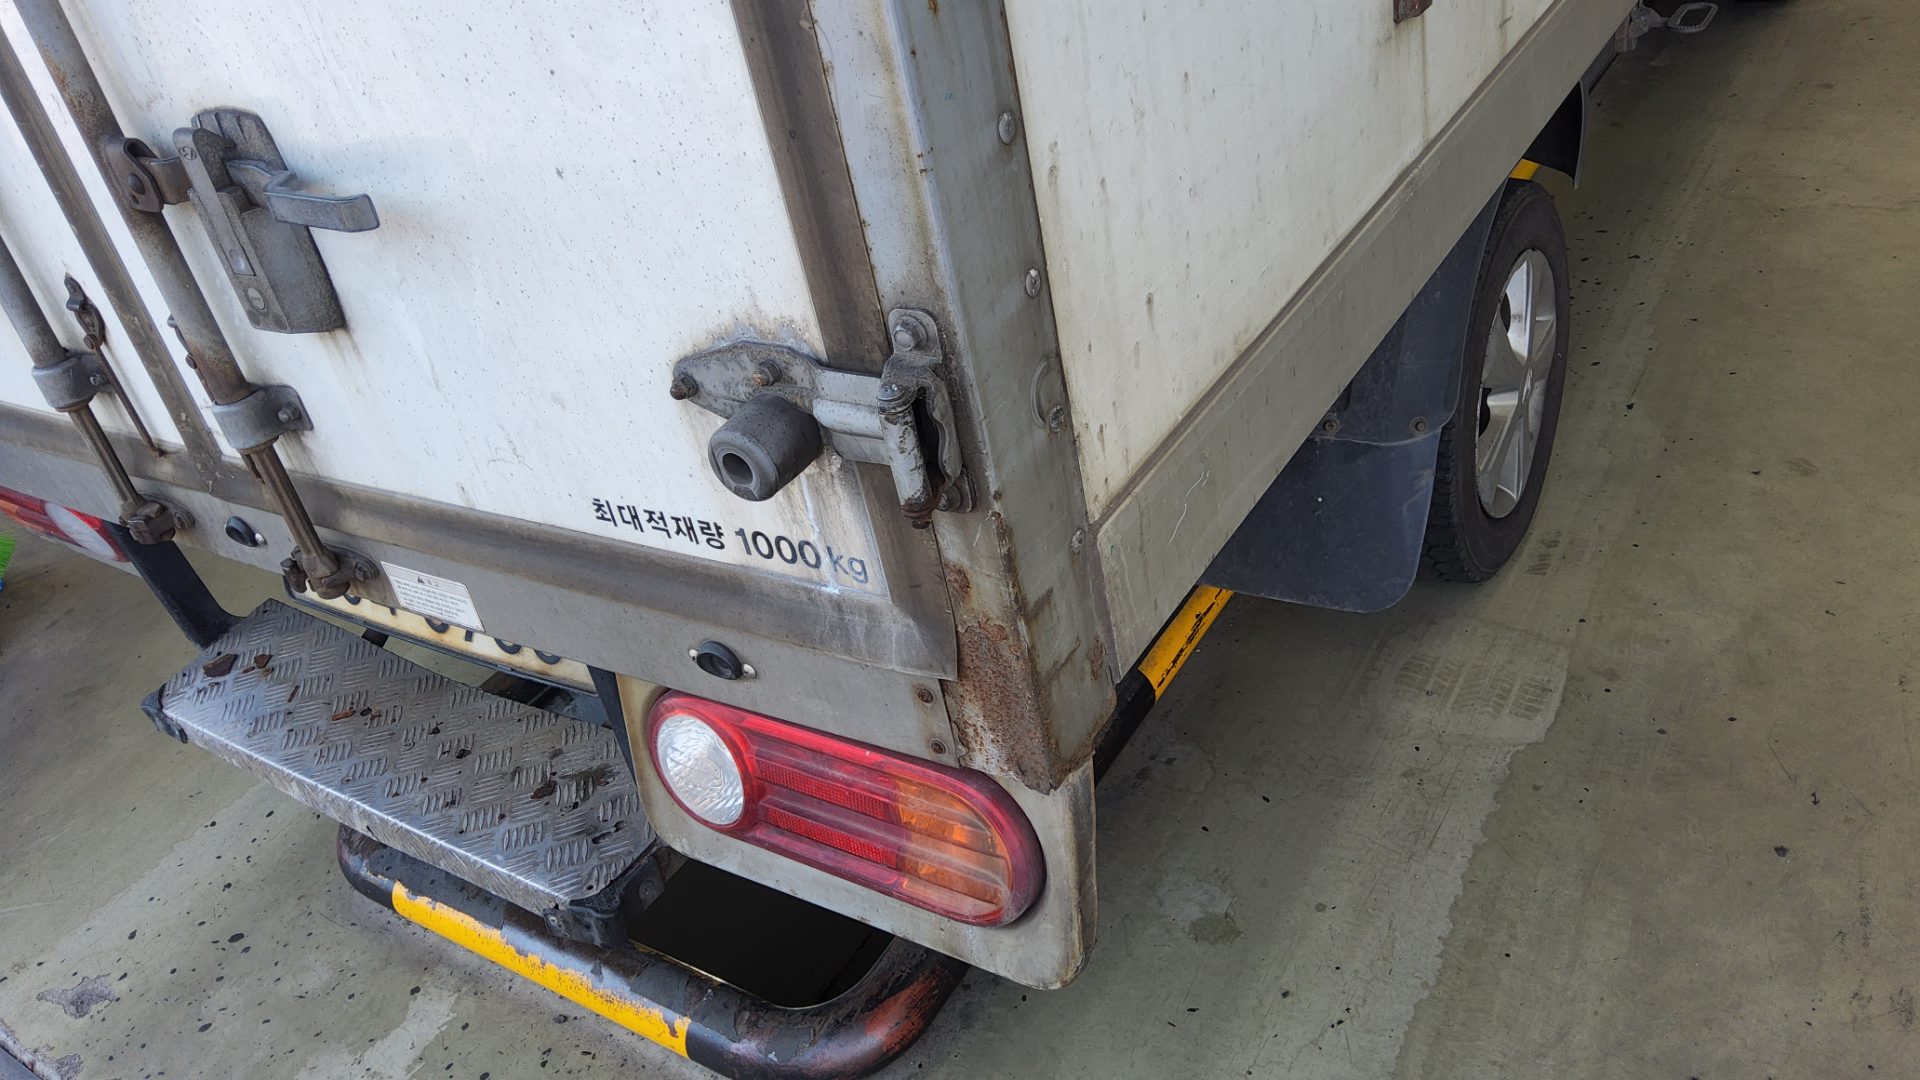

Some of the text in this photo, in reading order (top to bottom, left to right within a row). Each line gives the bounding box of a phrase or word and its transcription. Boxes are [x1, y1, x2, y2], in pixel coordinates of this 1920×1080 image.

[592, 498, 869, 584] 최대적재량 1000 kg
